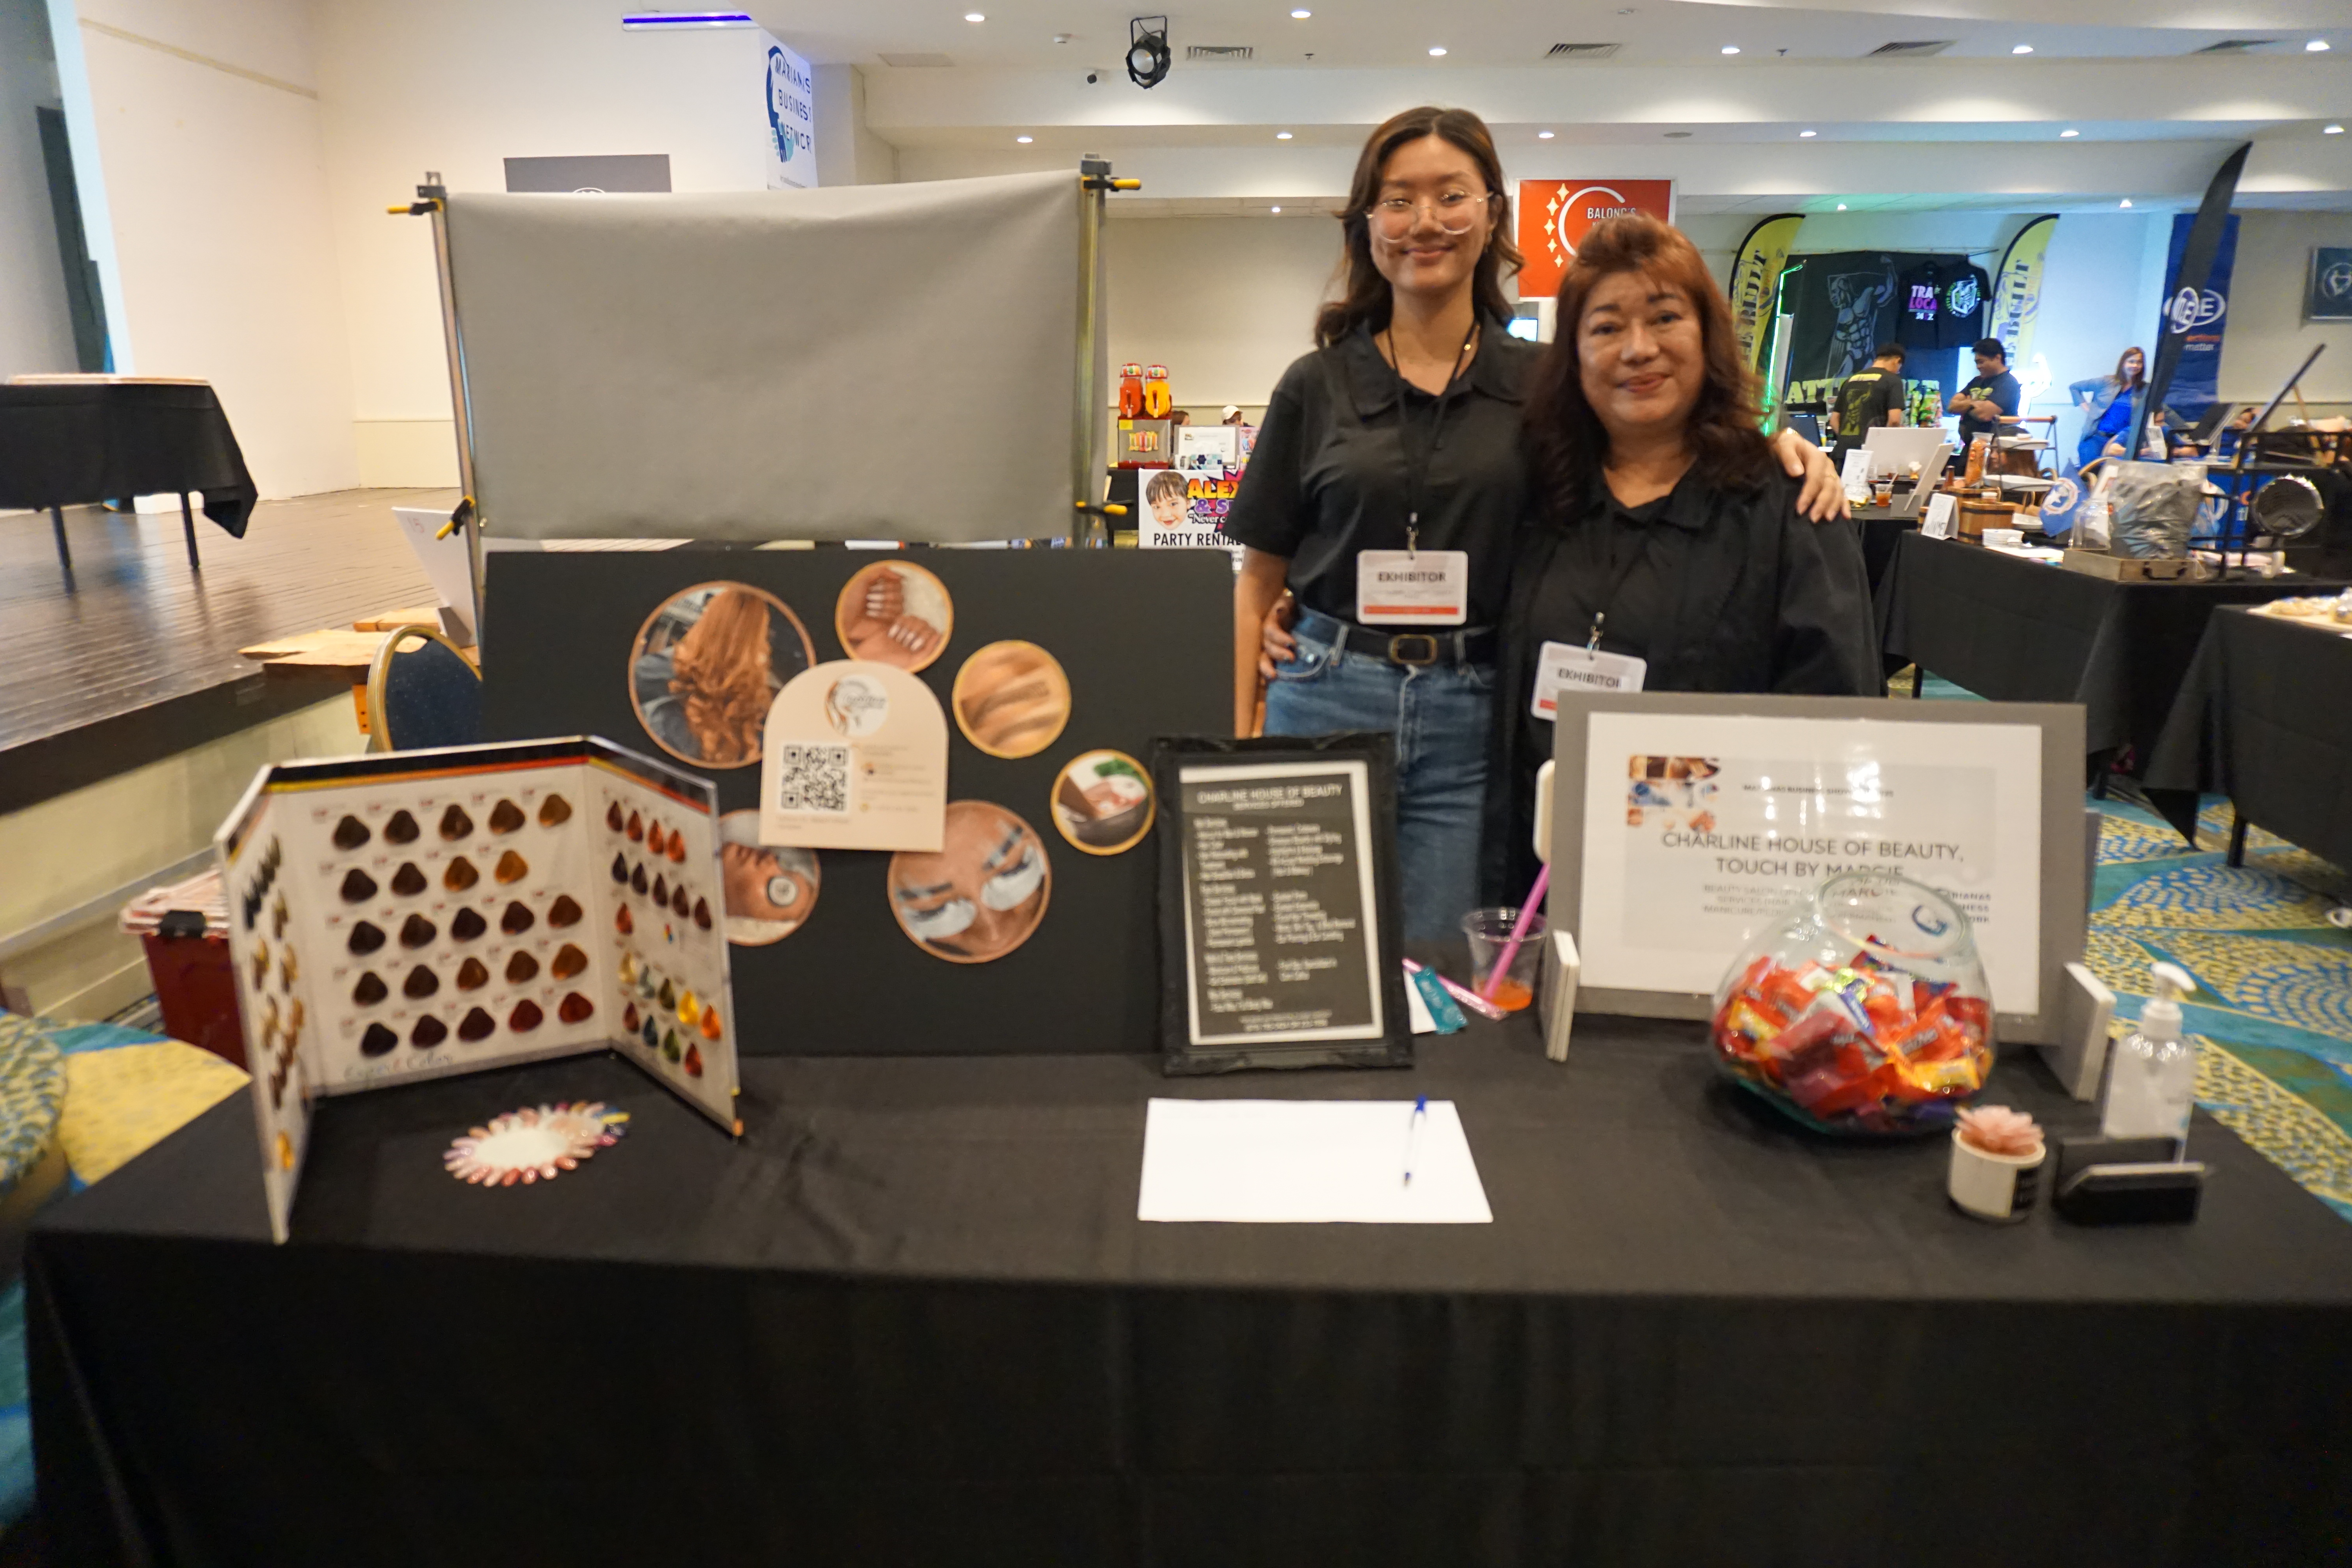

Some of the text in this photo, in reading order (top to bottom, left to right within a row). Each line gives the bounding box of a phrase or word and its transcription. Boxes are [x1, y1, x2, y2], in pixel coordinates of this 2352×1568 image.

[1154, 533, 1192, 546] PARTY
[1378, 571, 1446, 583] EXHIBITOR
[1662, 832, 1964, 862] CHARLINE HOUSE OF BEAUTY,
[1716, 857, 1787, 875] TOUCH
[1795, 862, 1820, 877] BY
